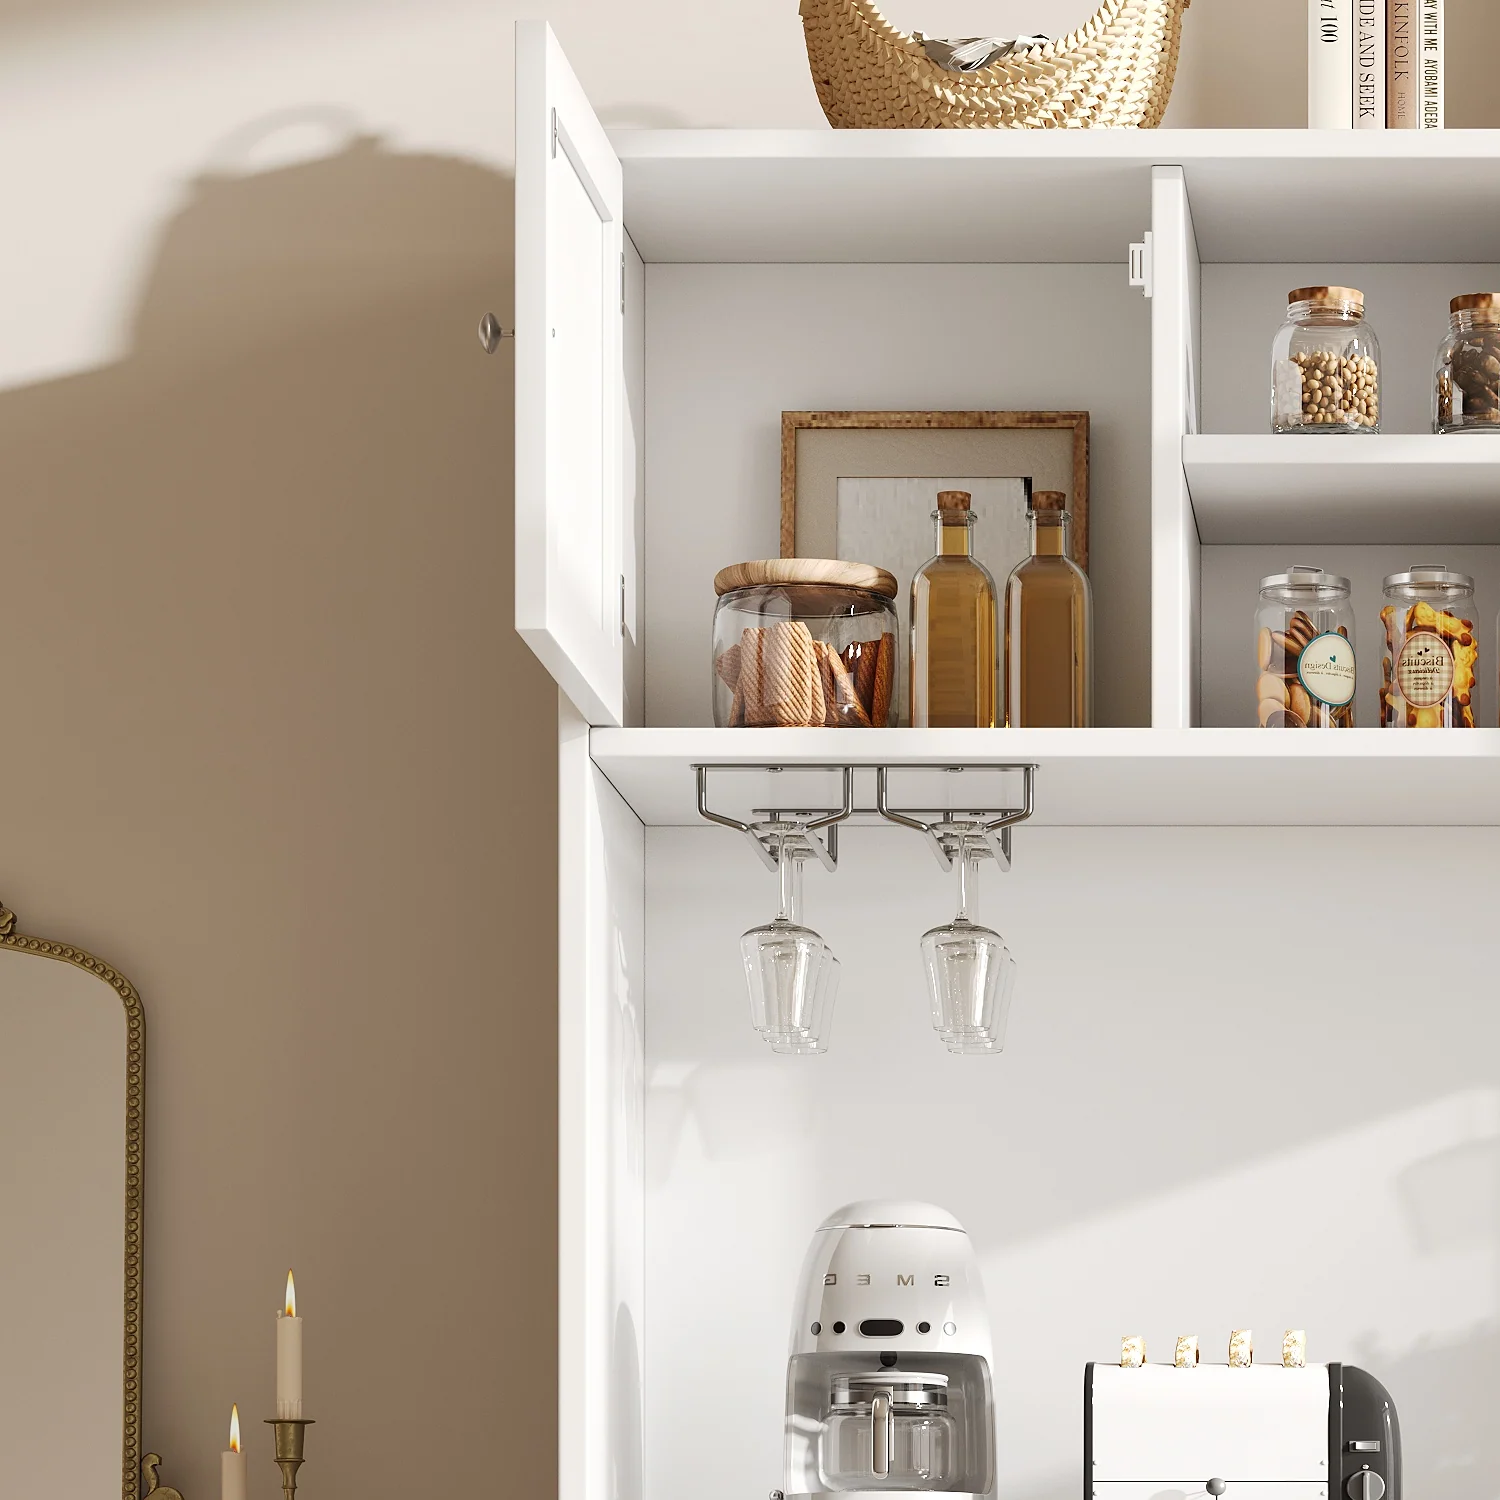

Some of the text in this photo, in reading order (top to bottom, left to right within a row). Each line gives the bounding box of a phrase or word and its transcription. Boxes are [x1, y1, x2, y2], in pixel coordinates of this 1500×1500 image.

[1320, 17, 1338, 43] 100
[1423, 12, 1438, 35] WITH
[1359, 31, 1375, 68] AND
[1394, 2, 1409, 119] KINFOLK HOME
[1423, 38, 1438, 52] ME
[1359, 73, 1375, 118] SEEK
[1423, 59, 1438, 98] AYOBAMI
